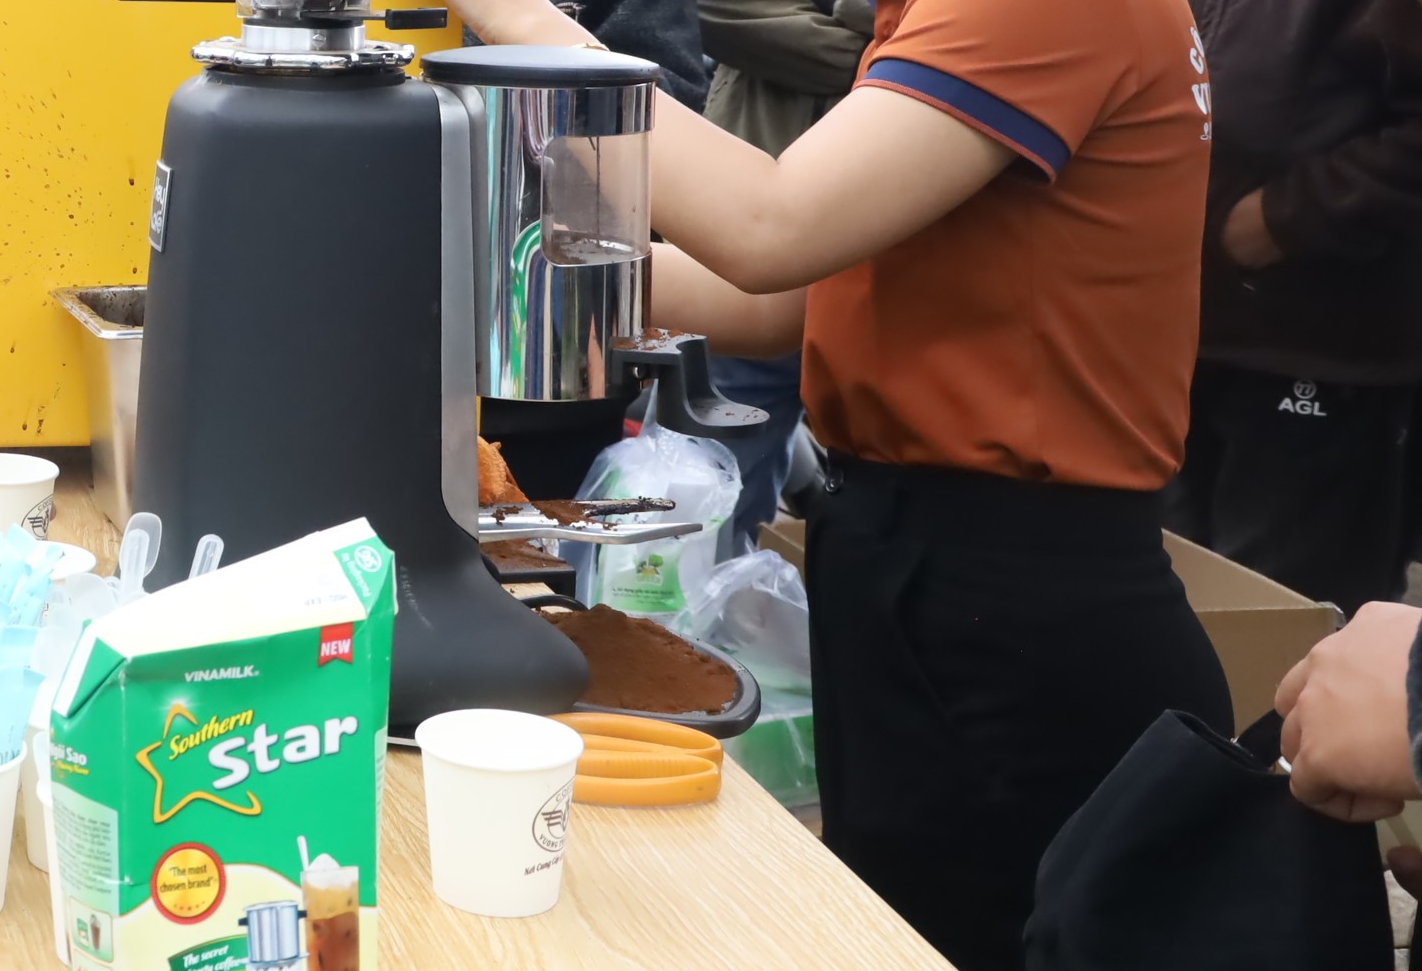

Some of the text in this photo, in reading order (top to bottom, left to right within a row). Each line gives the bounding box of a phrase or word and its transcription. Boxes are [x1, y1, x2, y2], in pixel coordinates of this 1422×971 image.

[1278, 397, 1327, 416] AGL
[320, 638, 351, 657] NEW
[184, 665, 255, 682] VINAMILK
[169, 709, 254, 761] Southern
[66, 747, 88, 766] Sao
[208, 716, 358, 790] Star
[188, 865, 207, 875] most
[160, 882, 187, 893] chosen
[183, 954, 200, 968] The
[201, 945, 229, 961] secret
